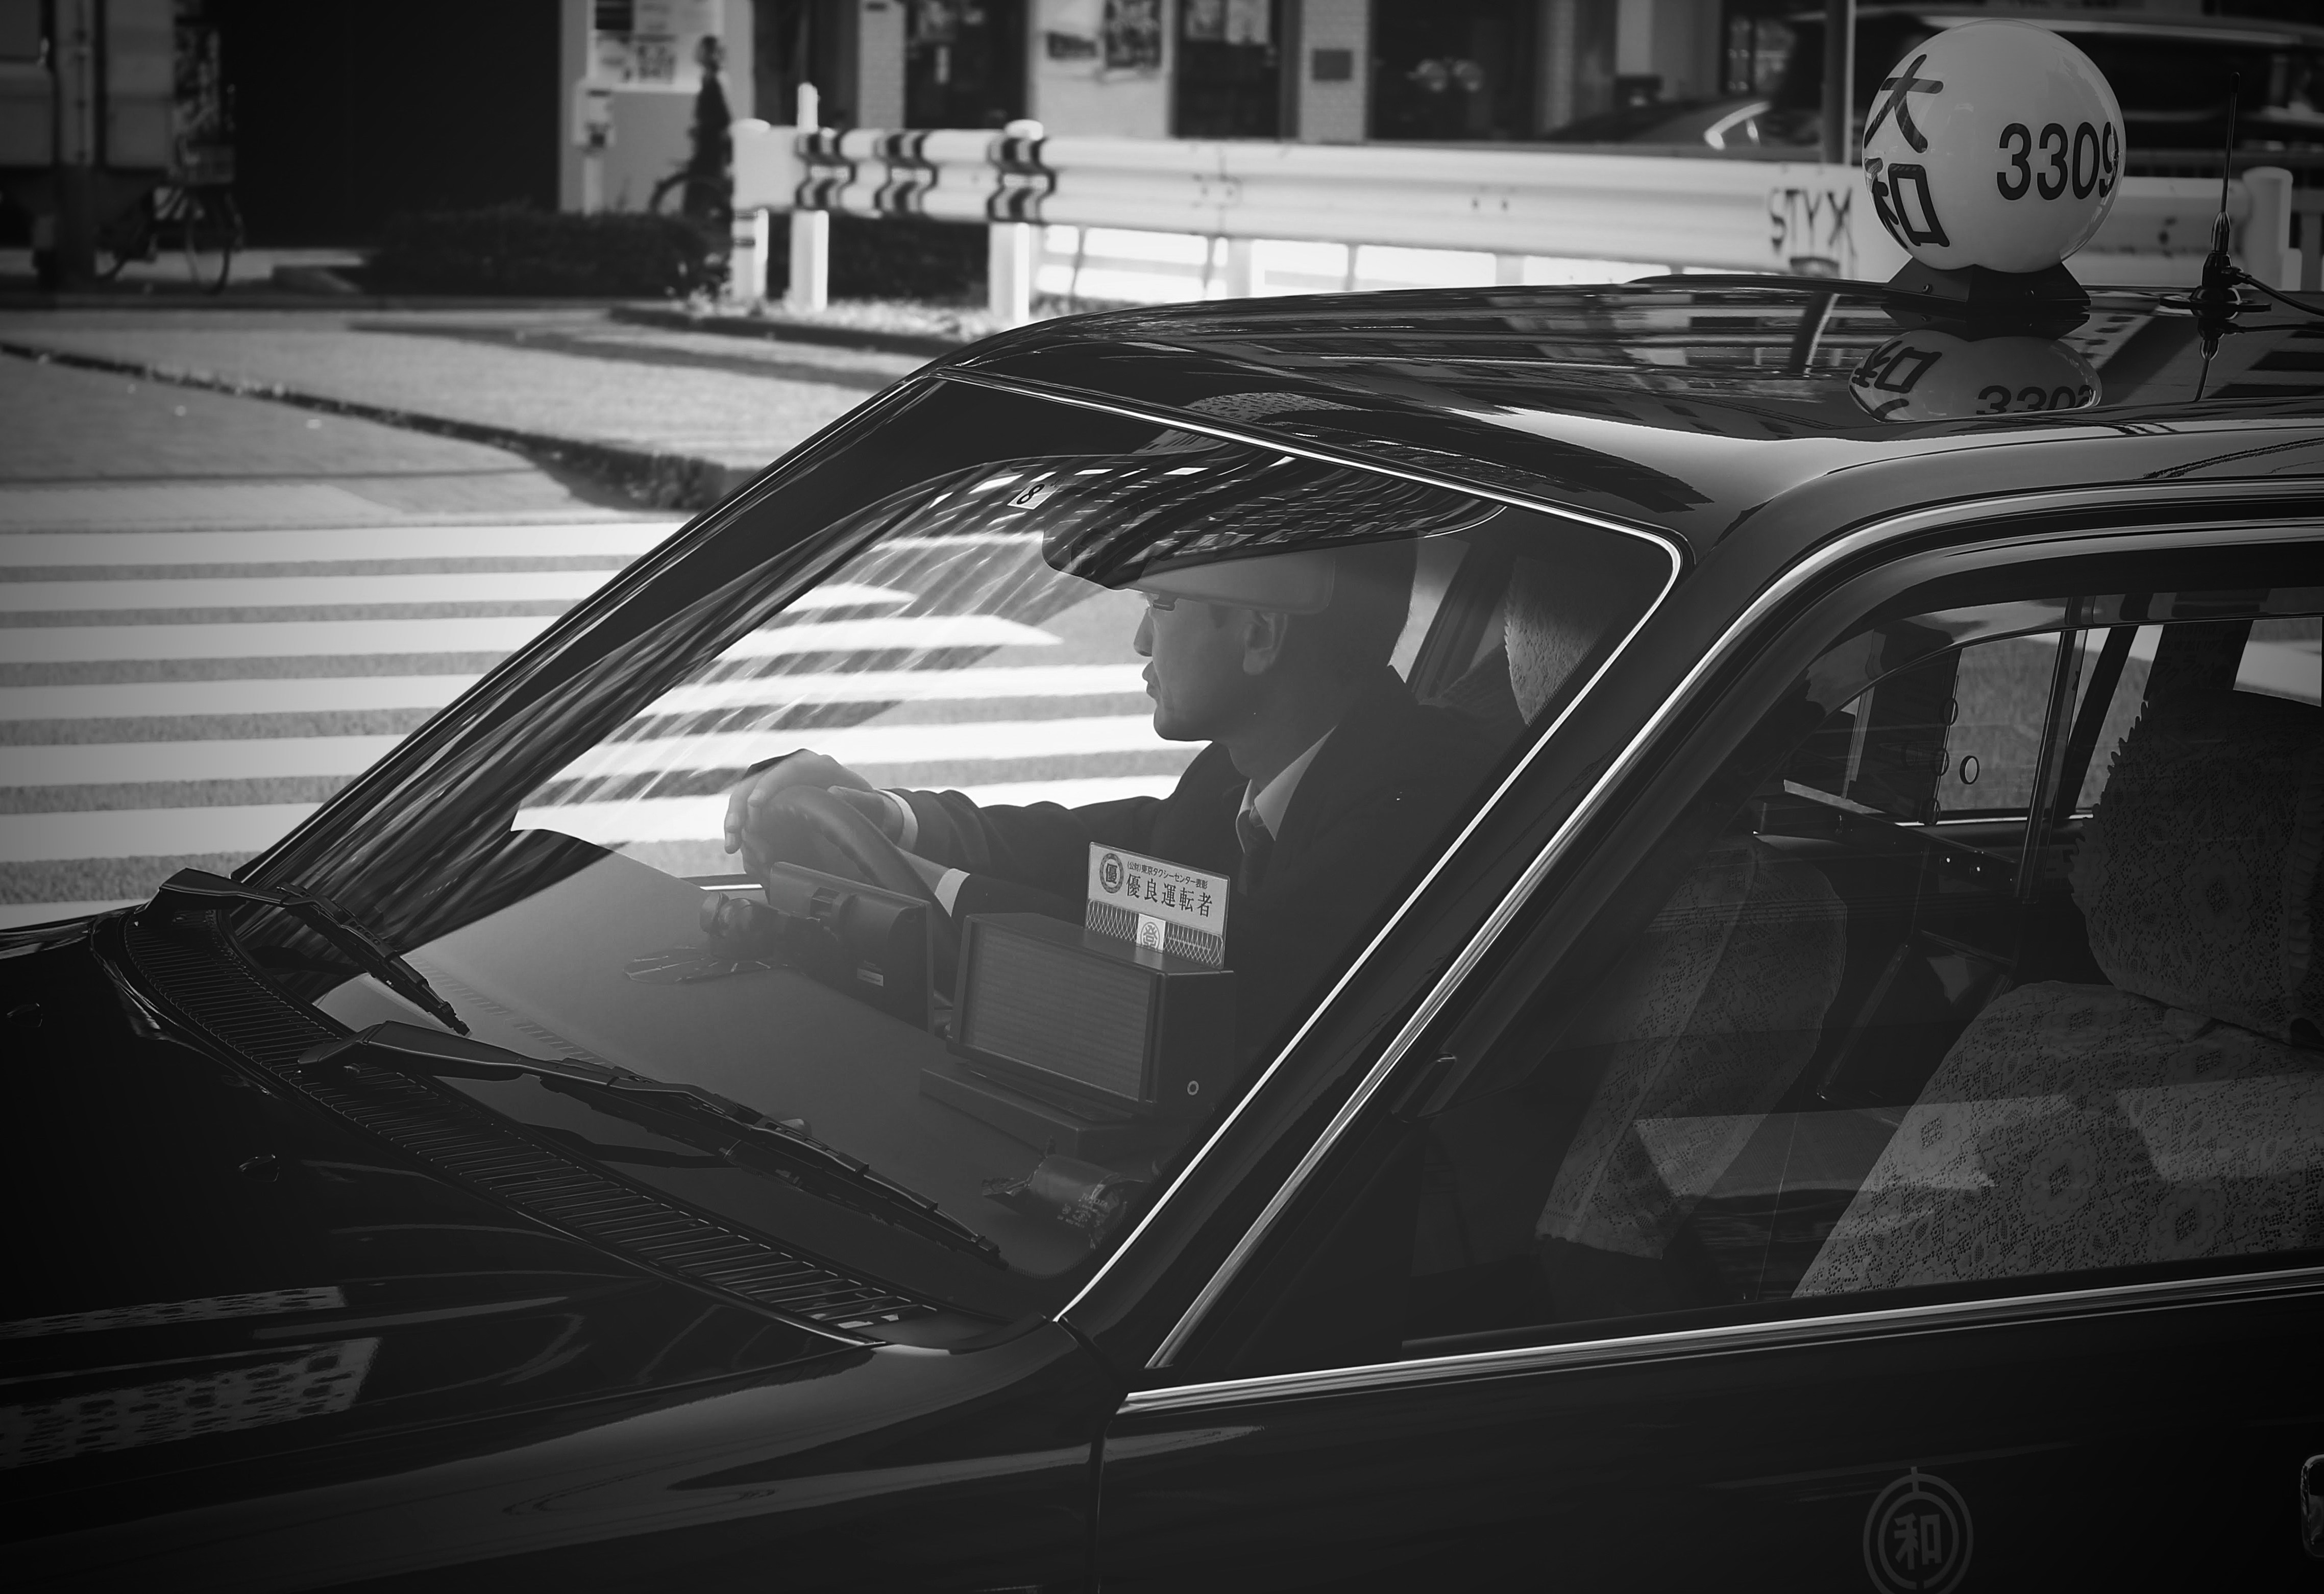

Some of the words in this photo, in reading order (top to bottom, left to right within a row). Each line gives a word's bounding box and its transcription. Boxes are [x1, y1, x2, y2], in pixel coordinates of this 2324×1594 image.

[1864, 54, 1949, 249] 大和
[1997, 122, 2118, 201] 3309
[1126, 873, 1213, 918] 優良運転者
[1893, 1512, 1942, 1571] 和
